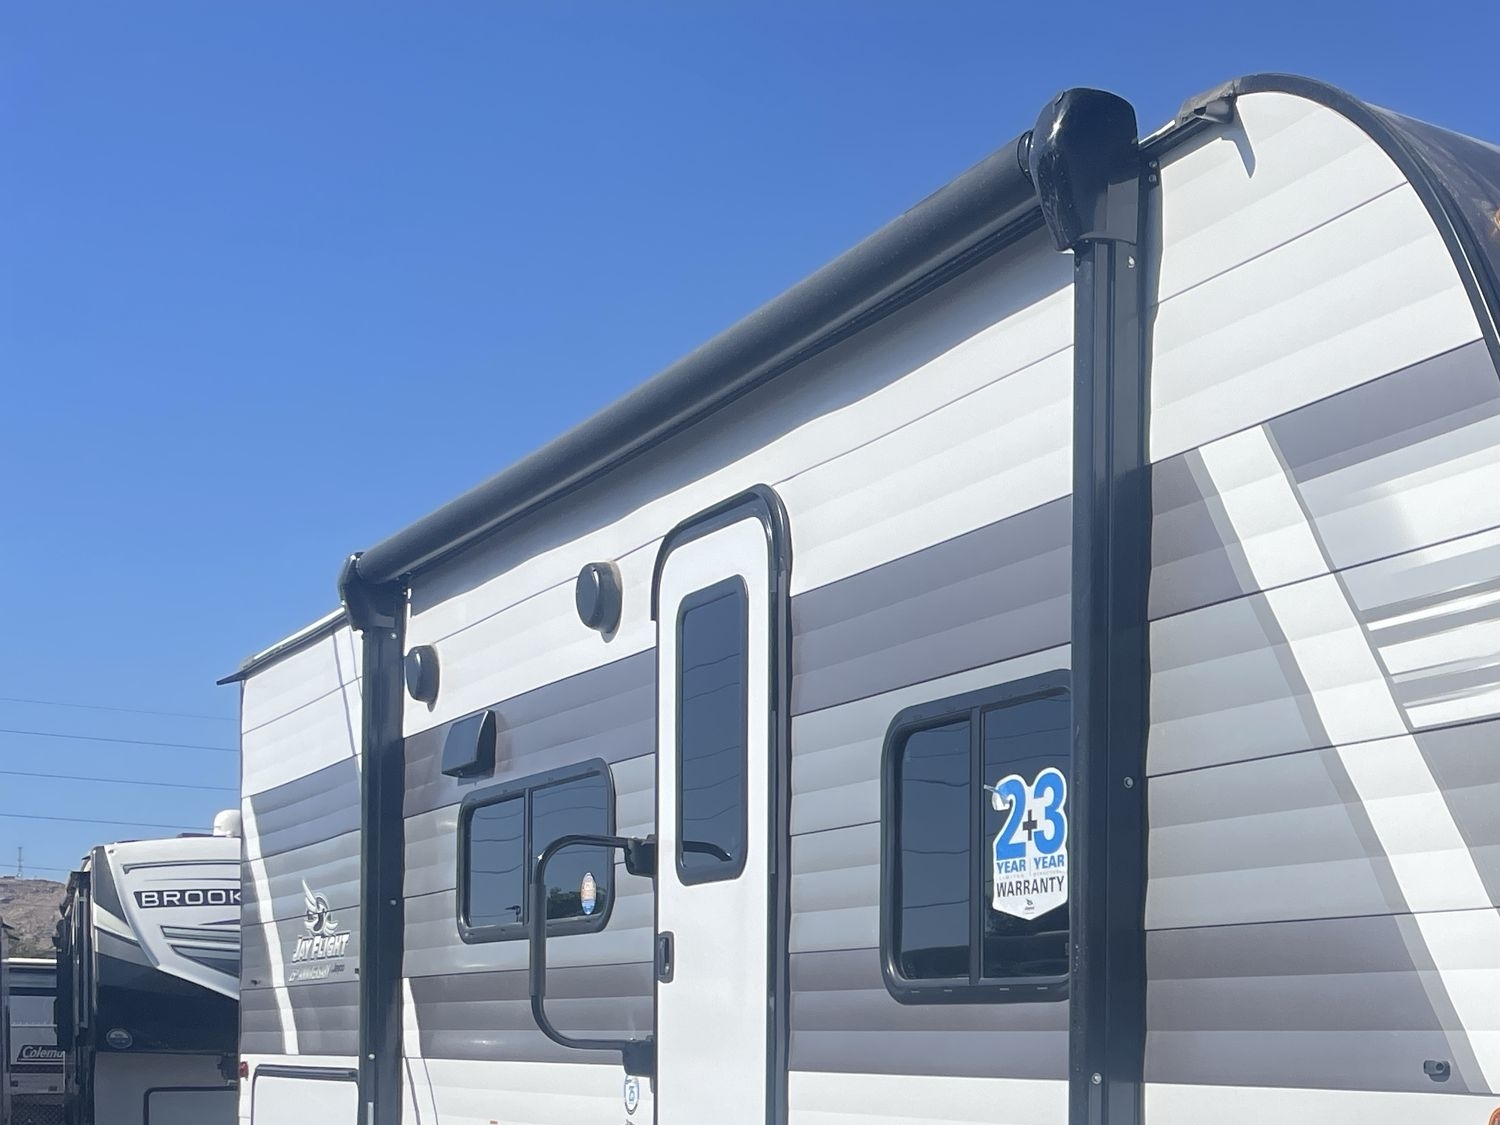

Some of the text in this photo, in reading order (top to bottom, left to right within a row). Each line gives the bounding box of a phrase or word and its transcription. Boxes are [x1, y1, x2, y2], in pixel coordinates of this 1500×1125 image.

[996, 859, 1026, 874] YEAR
[1033, 854, 1065, 870] YEAR
[996, 876, 1065, 898] WARRANTY
[310, 931, 351, 960] FLIGHT
